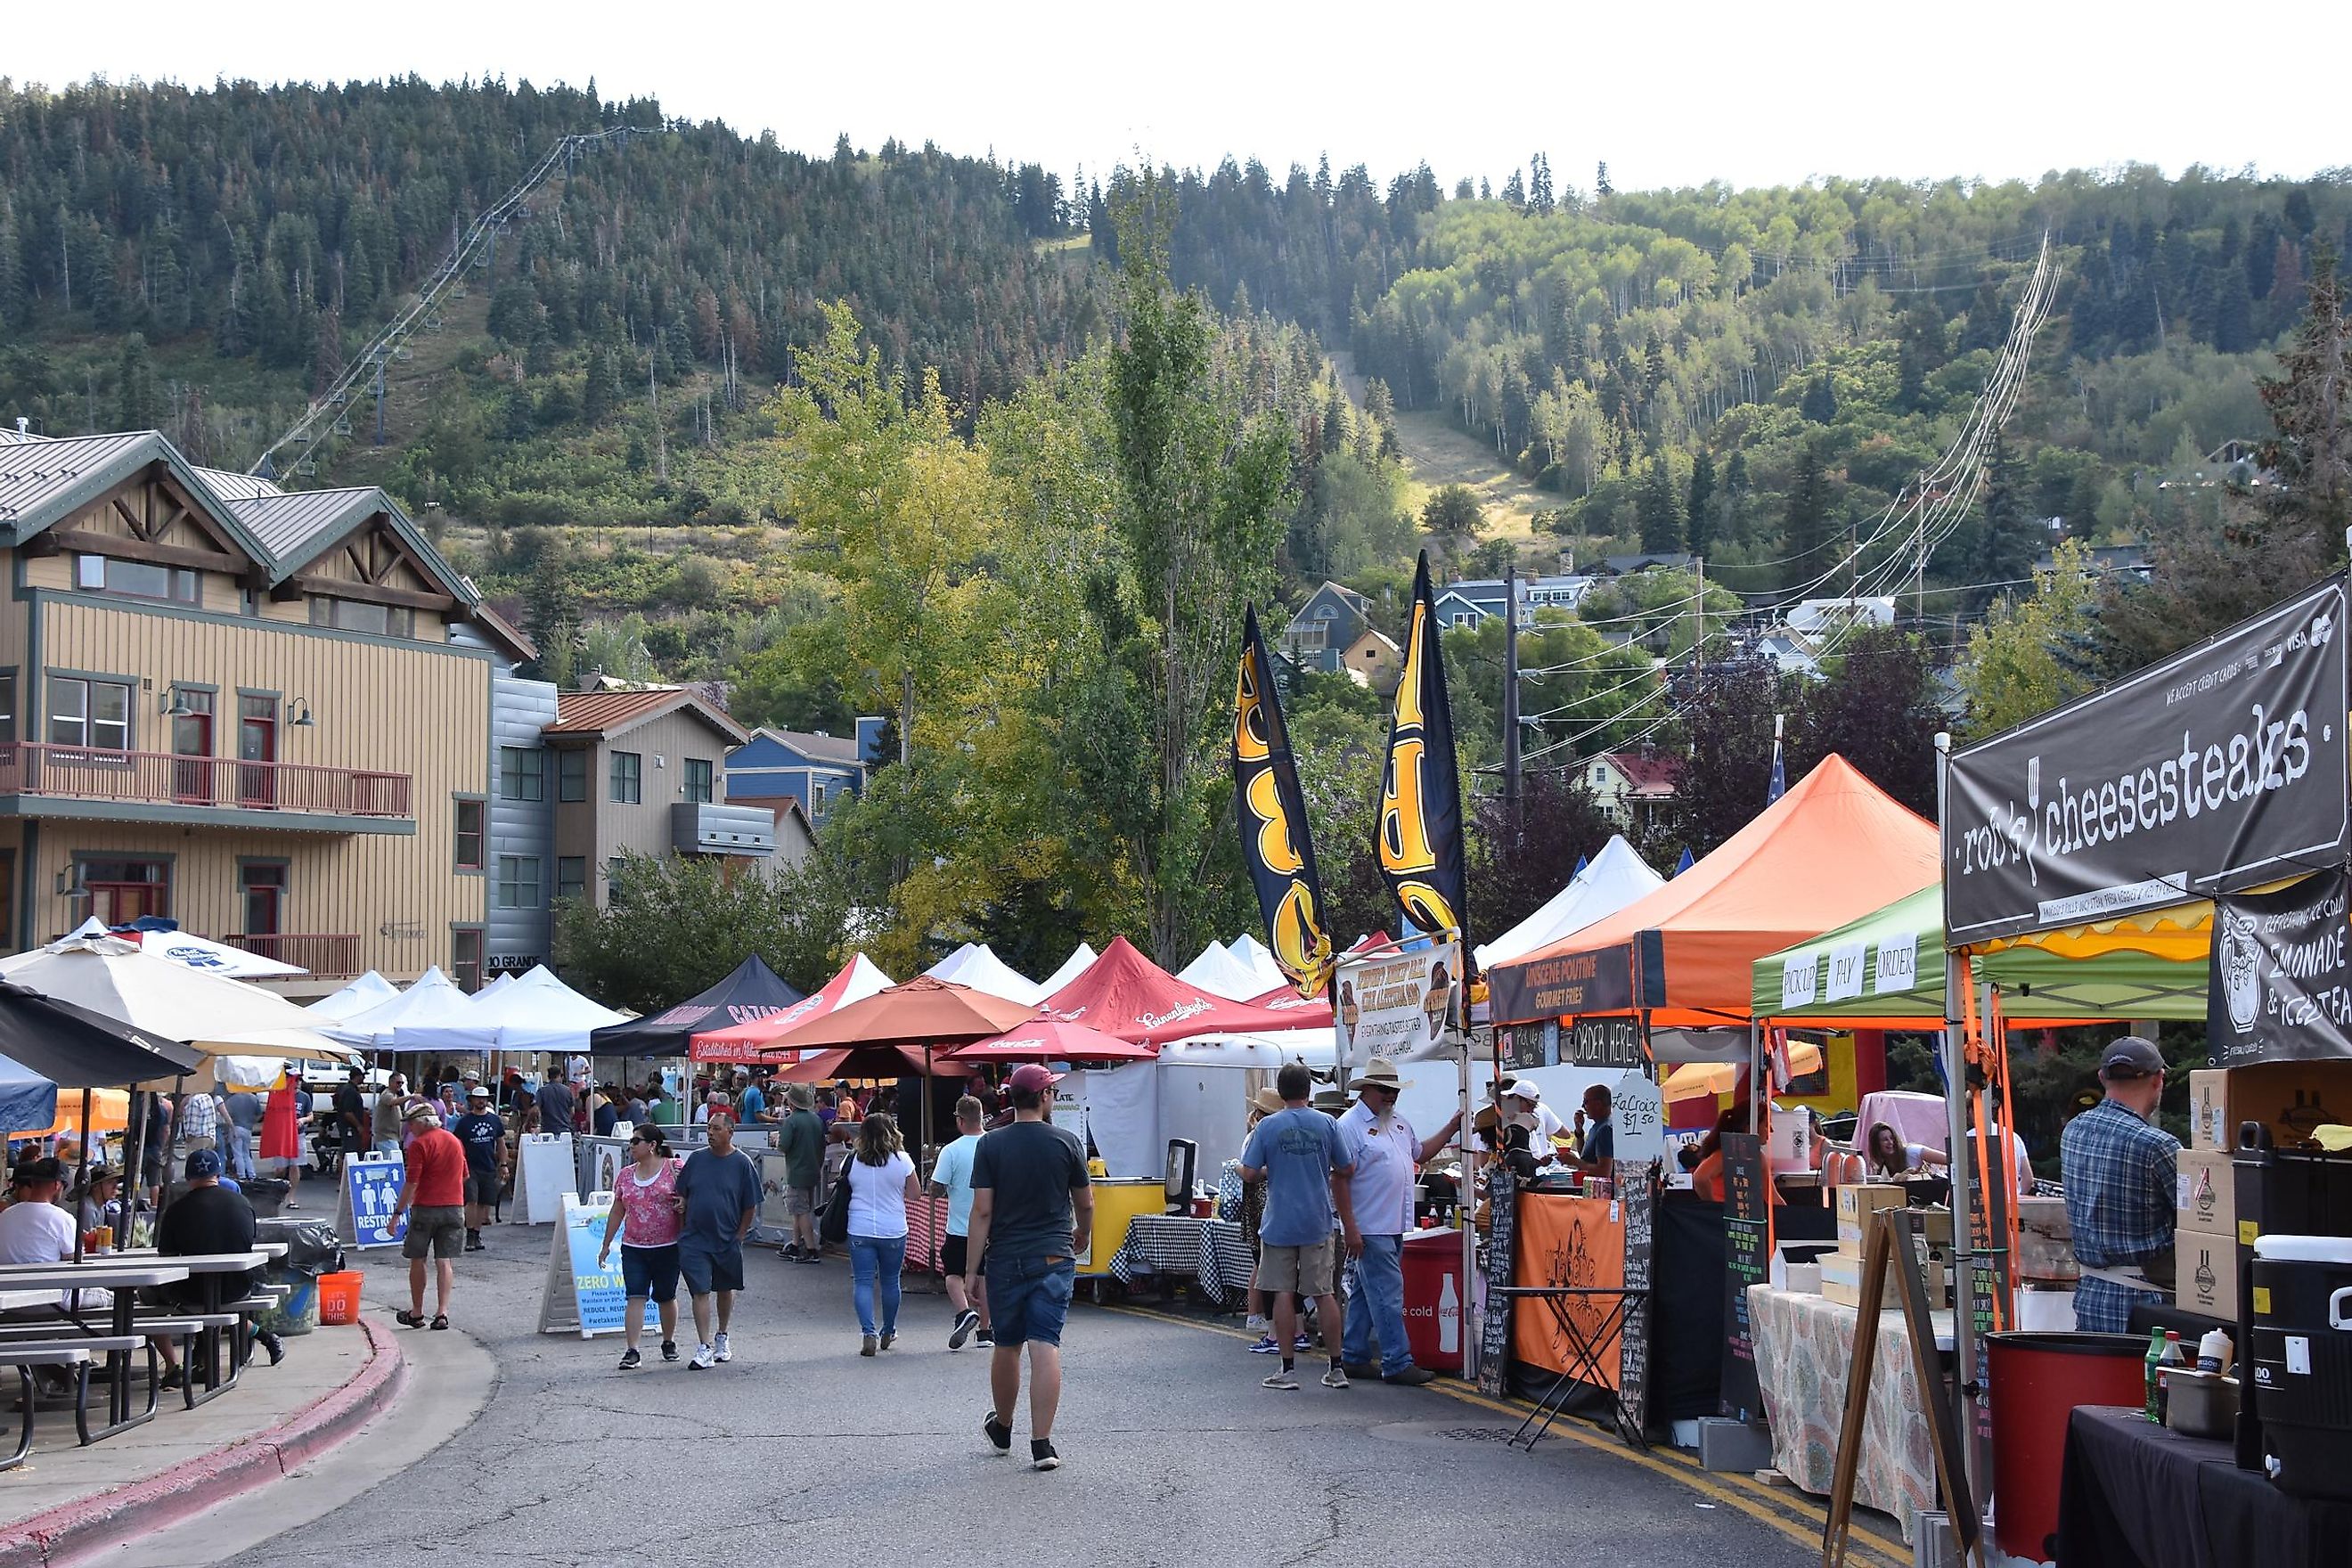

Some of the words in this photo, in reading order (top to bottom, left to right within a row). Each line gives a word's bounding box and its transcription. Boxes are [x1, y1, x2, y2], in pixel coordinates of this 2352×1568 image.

[2287, 631, 2308, 652] VISA
[2175, 680, 2198, 702] ACCEPT
[2198, 671, 2219, 692] CREDIT
[1963, 800, 2028, 876] rob's
[2045, 703, 2310, 858] cheesesteaks
[2323, 894, 2345, 918] COLD
[502, 955, 541, 968] GRANDE
[1525, 960, 1561, 988] UNSCENE
[1561, 955, 1598, 983] POUTINE
[1835, 955, 1857, 987] PAY
[1877, 946, 1913, 978] ORDER
[1535, 988, 1566, 1009] GOURMET
[1565, 985, 1583, 1006] FRIES
[2267, 987, 2278, 1016] &
[2316, 984, 2352, 1030] TEA
[695, 1040, 731, 1060] Established
[1574, 1022, 1605, 1064] ORDER
[357, 1213, 408, 1229] RESTROM
[576, 1275, 608, 1290] ZERO
[327, 1299, 346, 1311] DO
[327, 1311, 347, 1321] THIS.
[609, 1304, 626, 1314] REUS
[1409, 1305, 1433, 1318] cold
